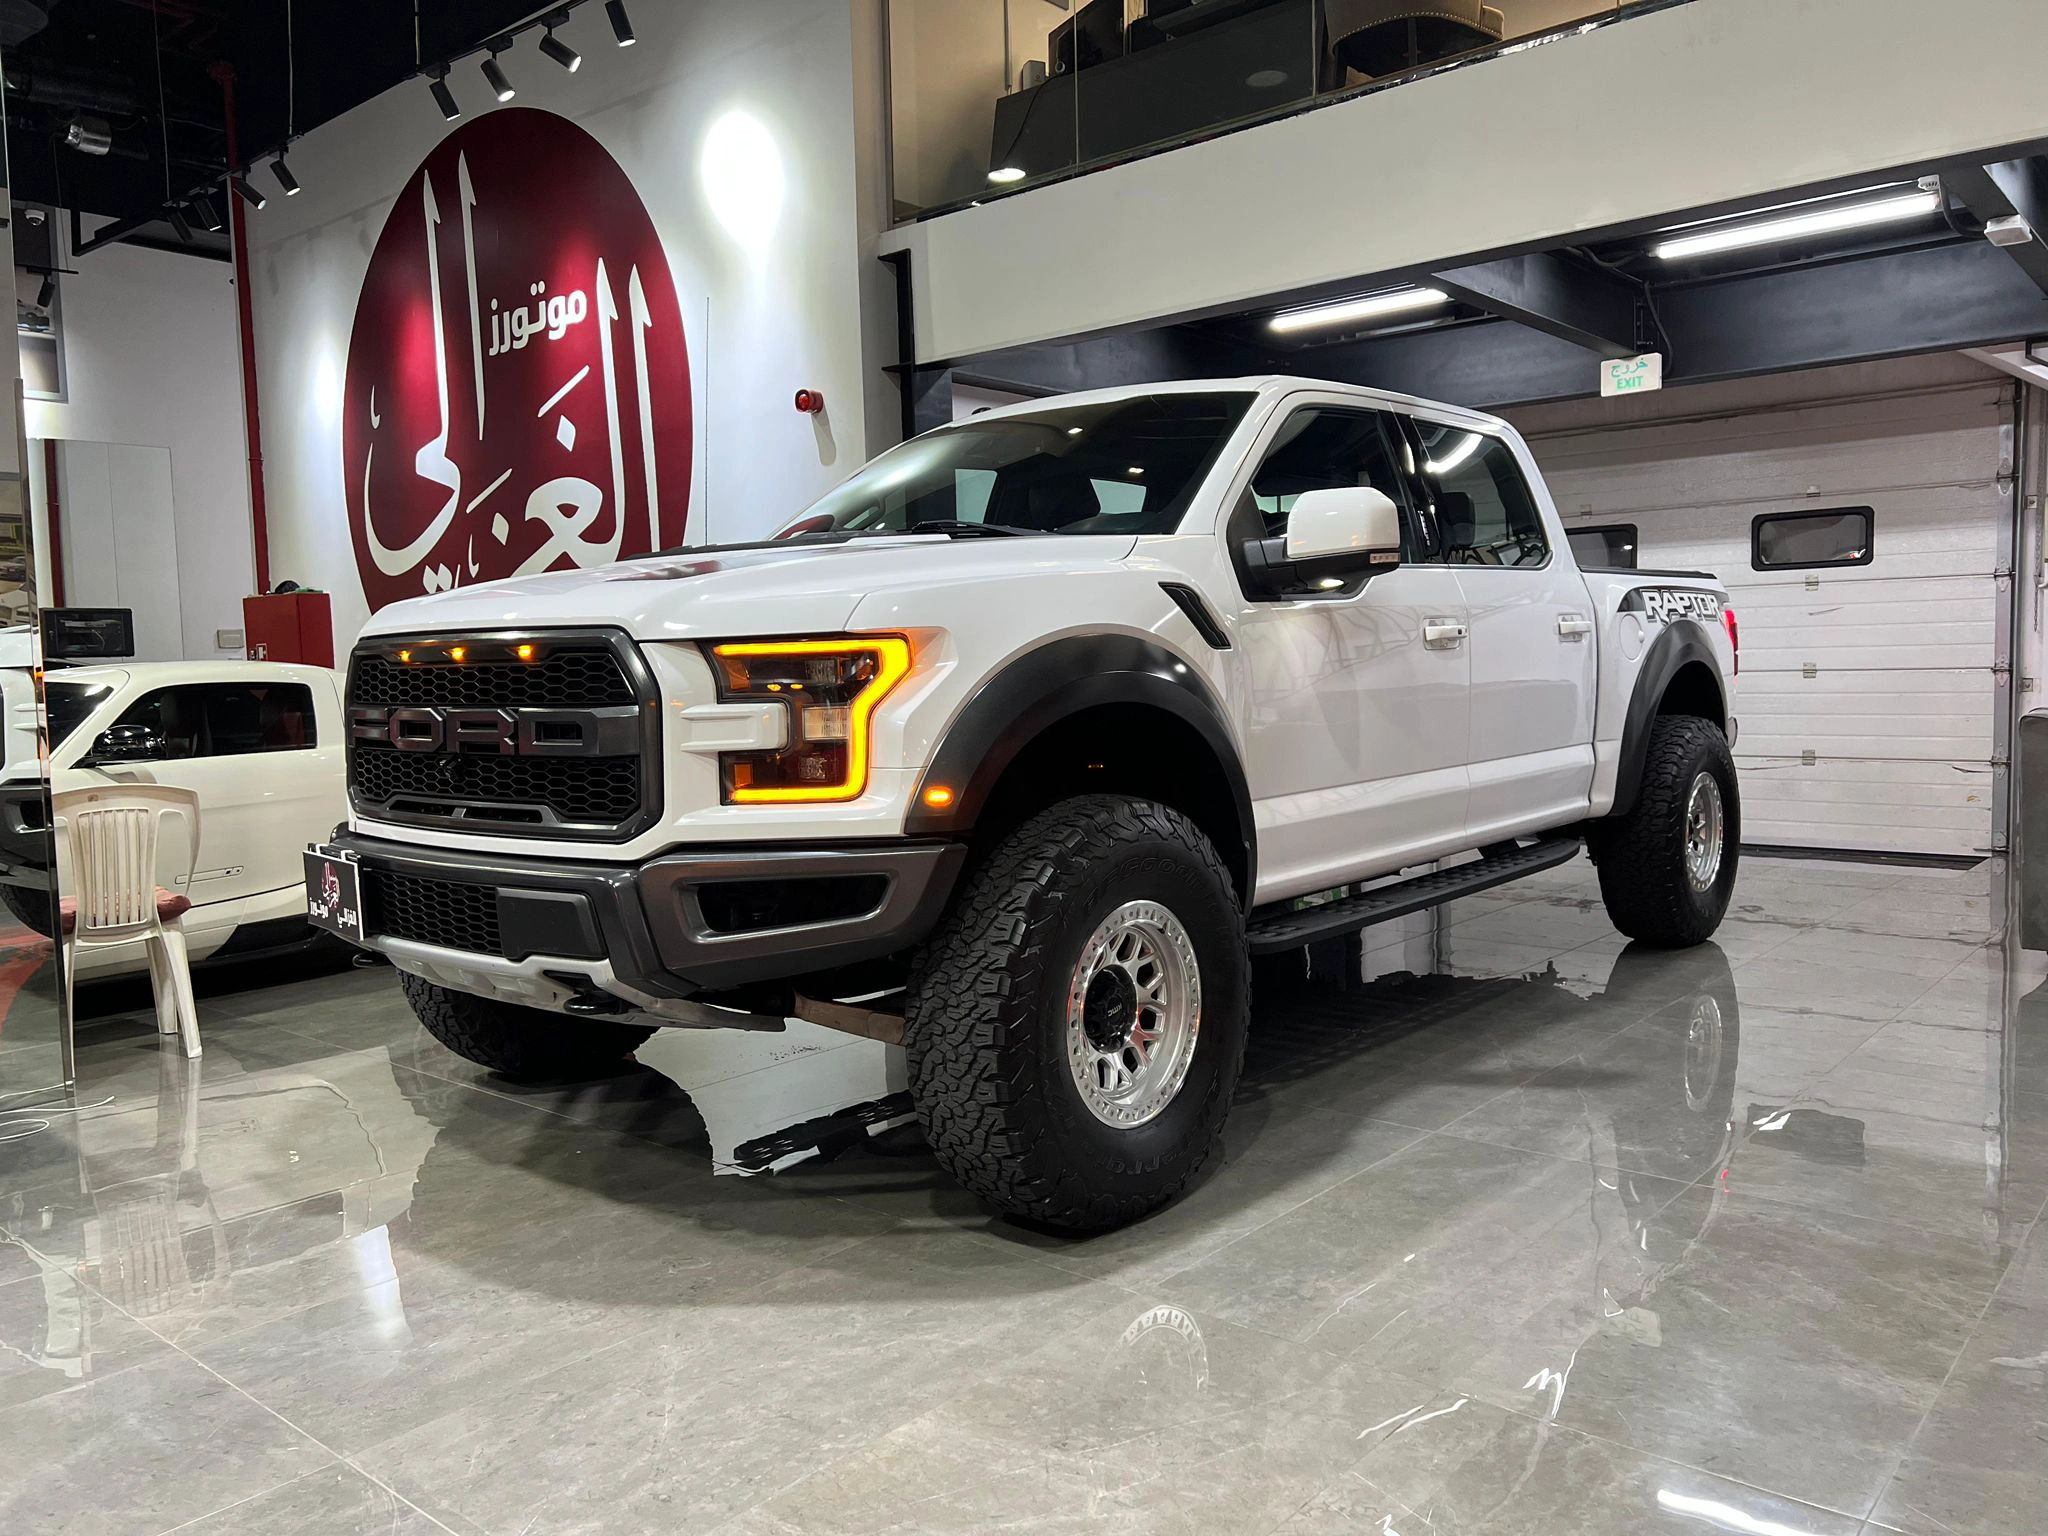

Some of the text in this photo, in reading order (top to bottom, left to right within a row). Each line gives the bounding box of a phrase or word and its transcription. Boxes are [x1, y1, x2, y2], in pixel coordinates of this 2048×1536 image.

[489, 280, 588, 356] موتورز
[1611, 358, 1648, 378] خروج
[1617, 376, 1643, 390] EXIT
[1640, 589, 1724, 624] RAPTOR
[350, 706, 599, 757] FORD
